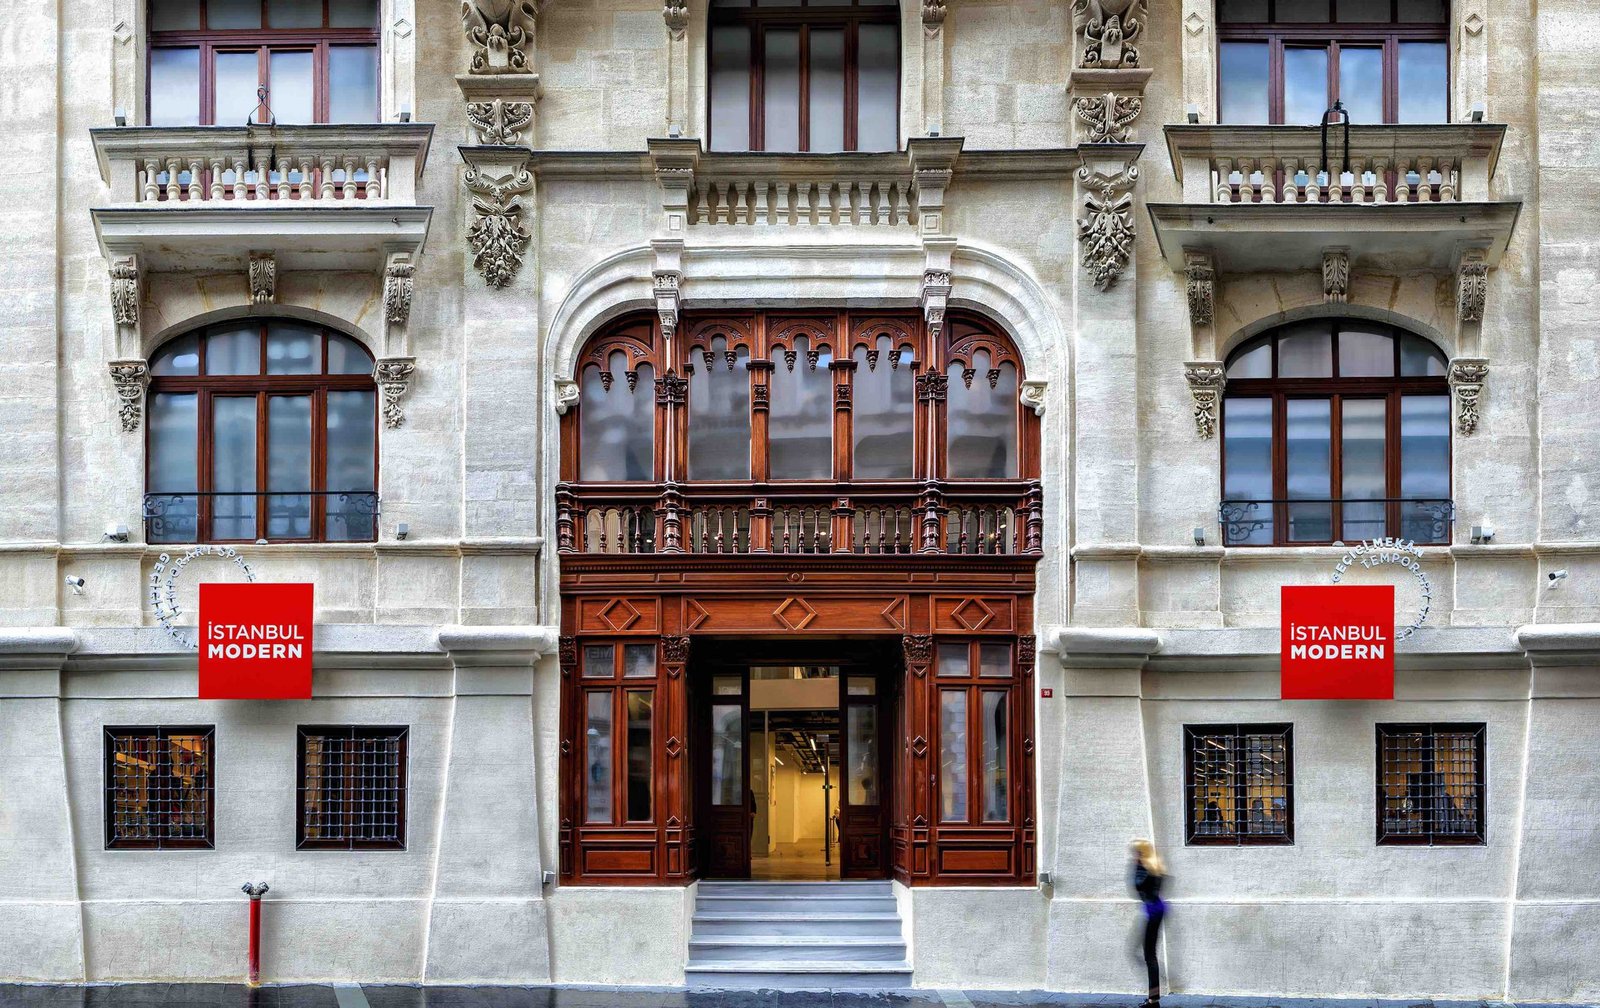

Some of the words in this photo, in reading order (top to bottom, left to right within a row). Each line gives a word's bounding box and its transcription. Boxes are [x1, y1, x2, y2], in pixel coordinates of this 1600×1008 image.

[1372, 537, 1425, 558] MEKÂN
[217, 547, 257, 583] SPACE
[1360, 552, 1433, 603] TEMPORARY
[207, 621, 304, 640] İSTANBUL
[1290, 623, 1386, 641] İSTANBUL
[207, 643, 303, 659] MODERN
[1290, 644, 1385, 660] MODERN
